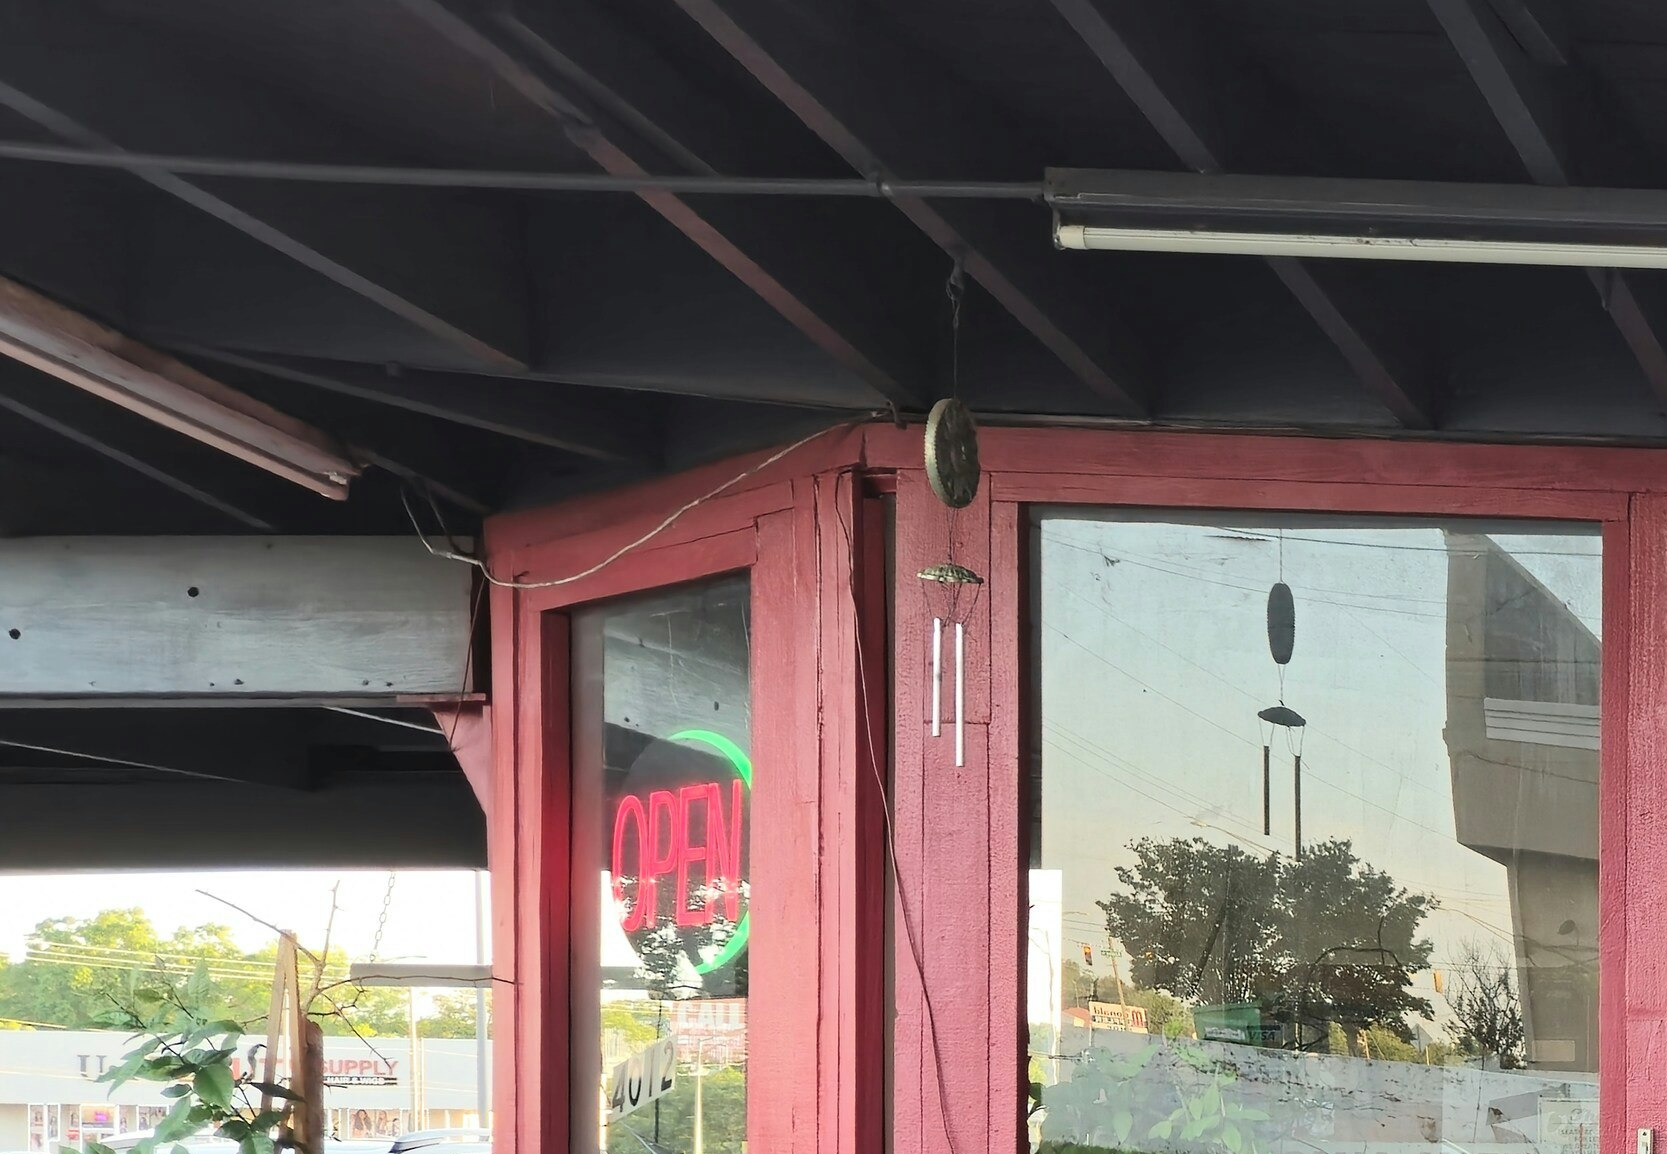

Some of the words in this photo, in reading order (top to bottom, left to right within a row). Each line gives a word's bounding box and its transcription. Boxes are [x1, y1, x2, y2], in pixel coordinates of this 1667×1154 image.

[612, 779, 742, 931] OPEN
[322, 1058, 399, 1075] SUPPLY
[612, 1040, 674, 1113] 4012
